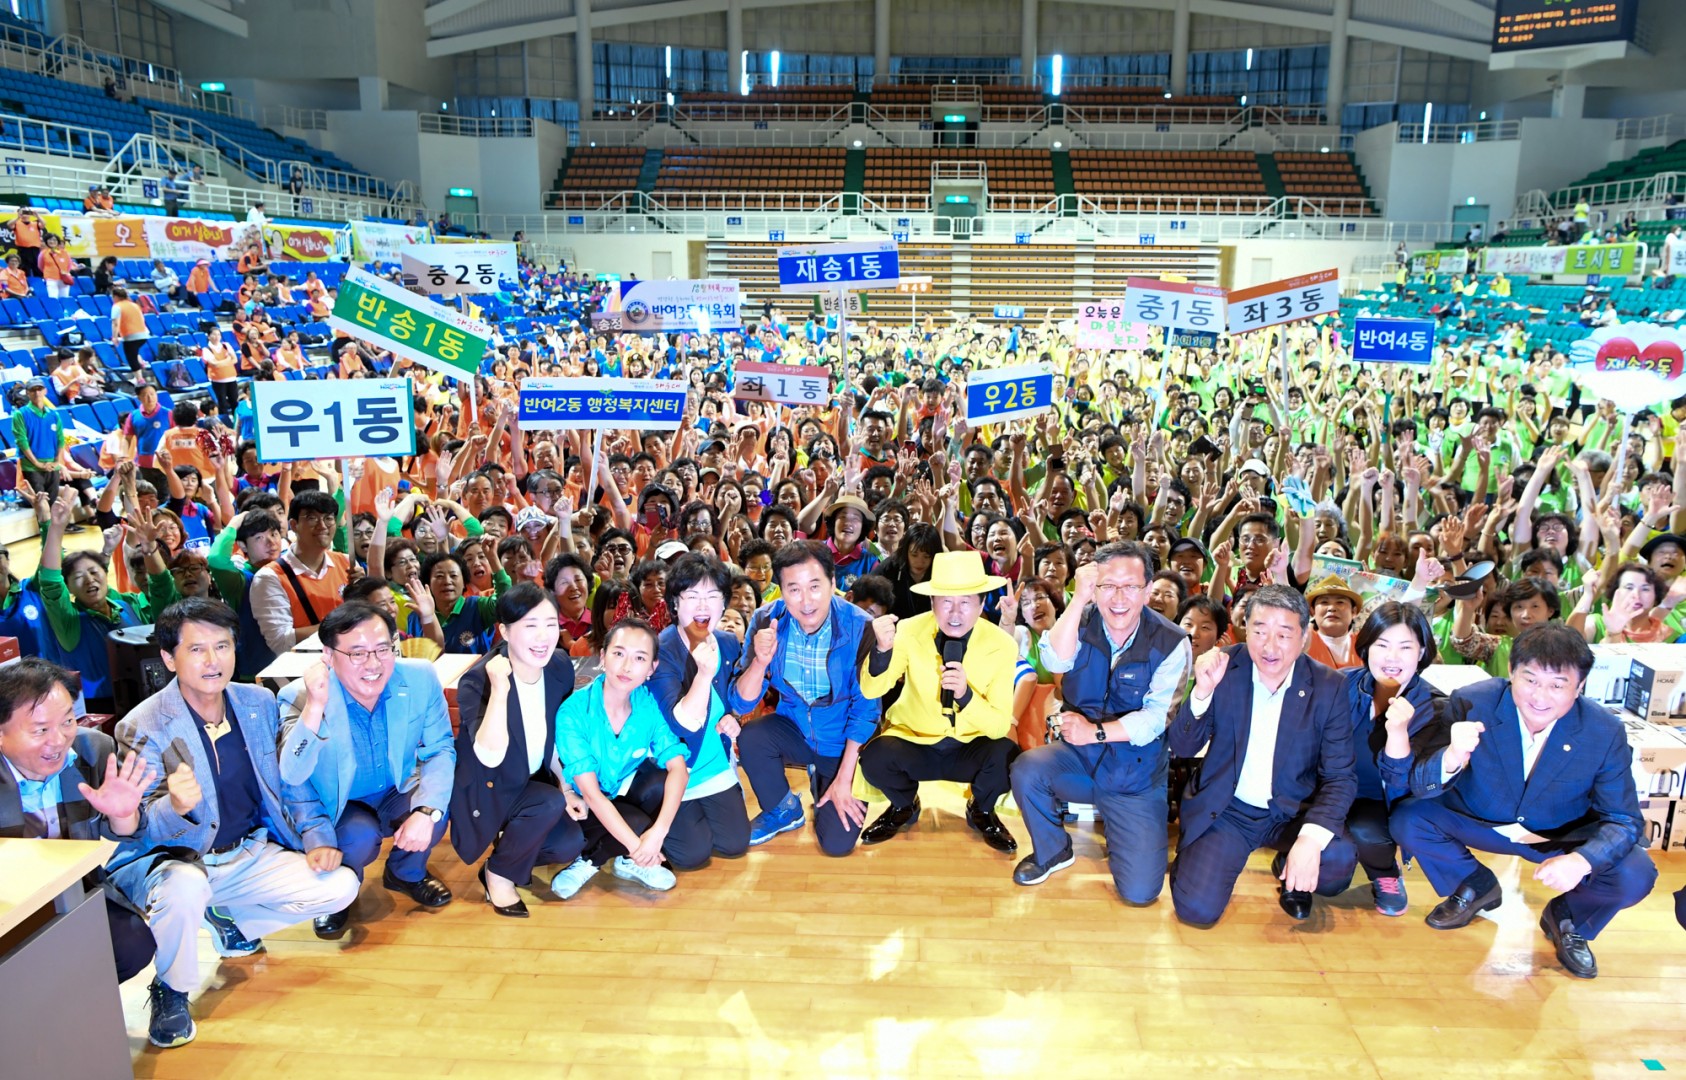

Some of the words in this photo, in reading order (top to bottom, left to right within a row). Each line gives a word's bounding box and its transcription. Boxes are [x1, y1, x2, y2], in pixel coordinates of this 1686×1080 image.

[427, 263, 496, 286] 중2동
[796, 254, 882, 282] 재송1동
[1085, 306, 1121, 319] 오늘은
[1136, 294, 1215, 326] 중1동
[1243, 287, 1325, 324] 좌3동
[355, 291, 466, 361] 반송1동
[1359, 329, 1428, 351] 반여4동
[741, 376, 822, 399] 좌1동
[984, 380, 1037, 412] 우2동
[524, 397, 582, 413] 반여2동
[587, 397, 680, 414] 행정복지센터
[267, 397, 403, 447] 우1동
